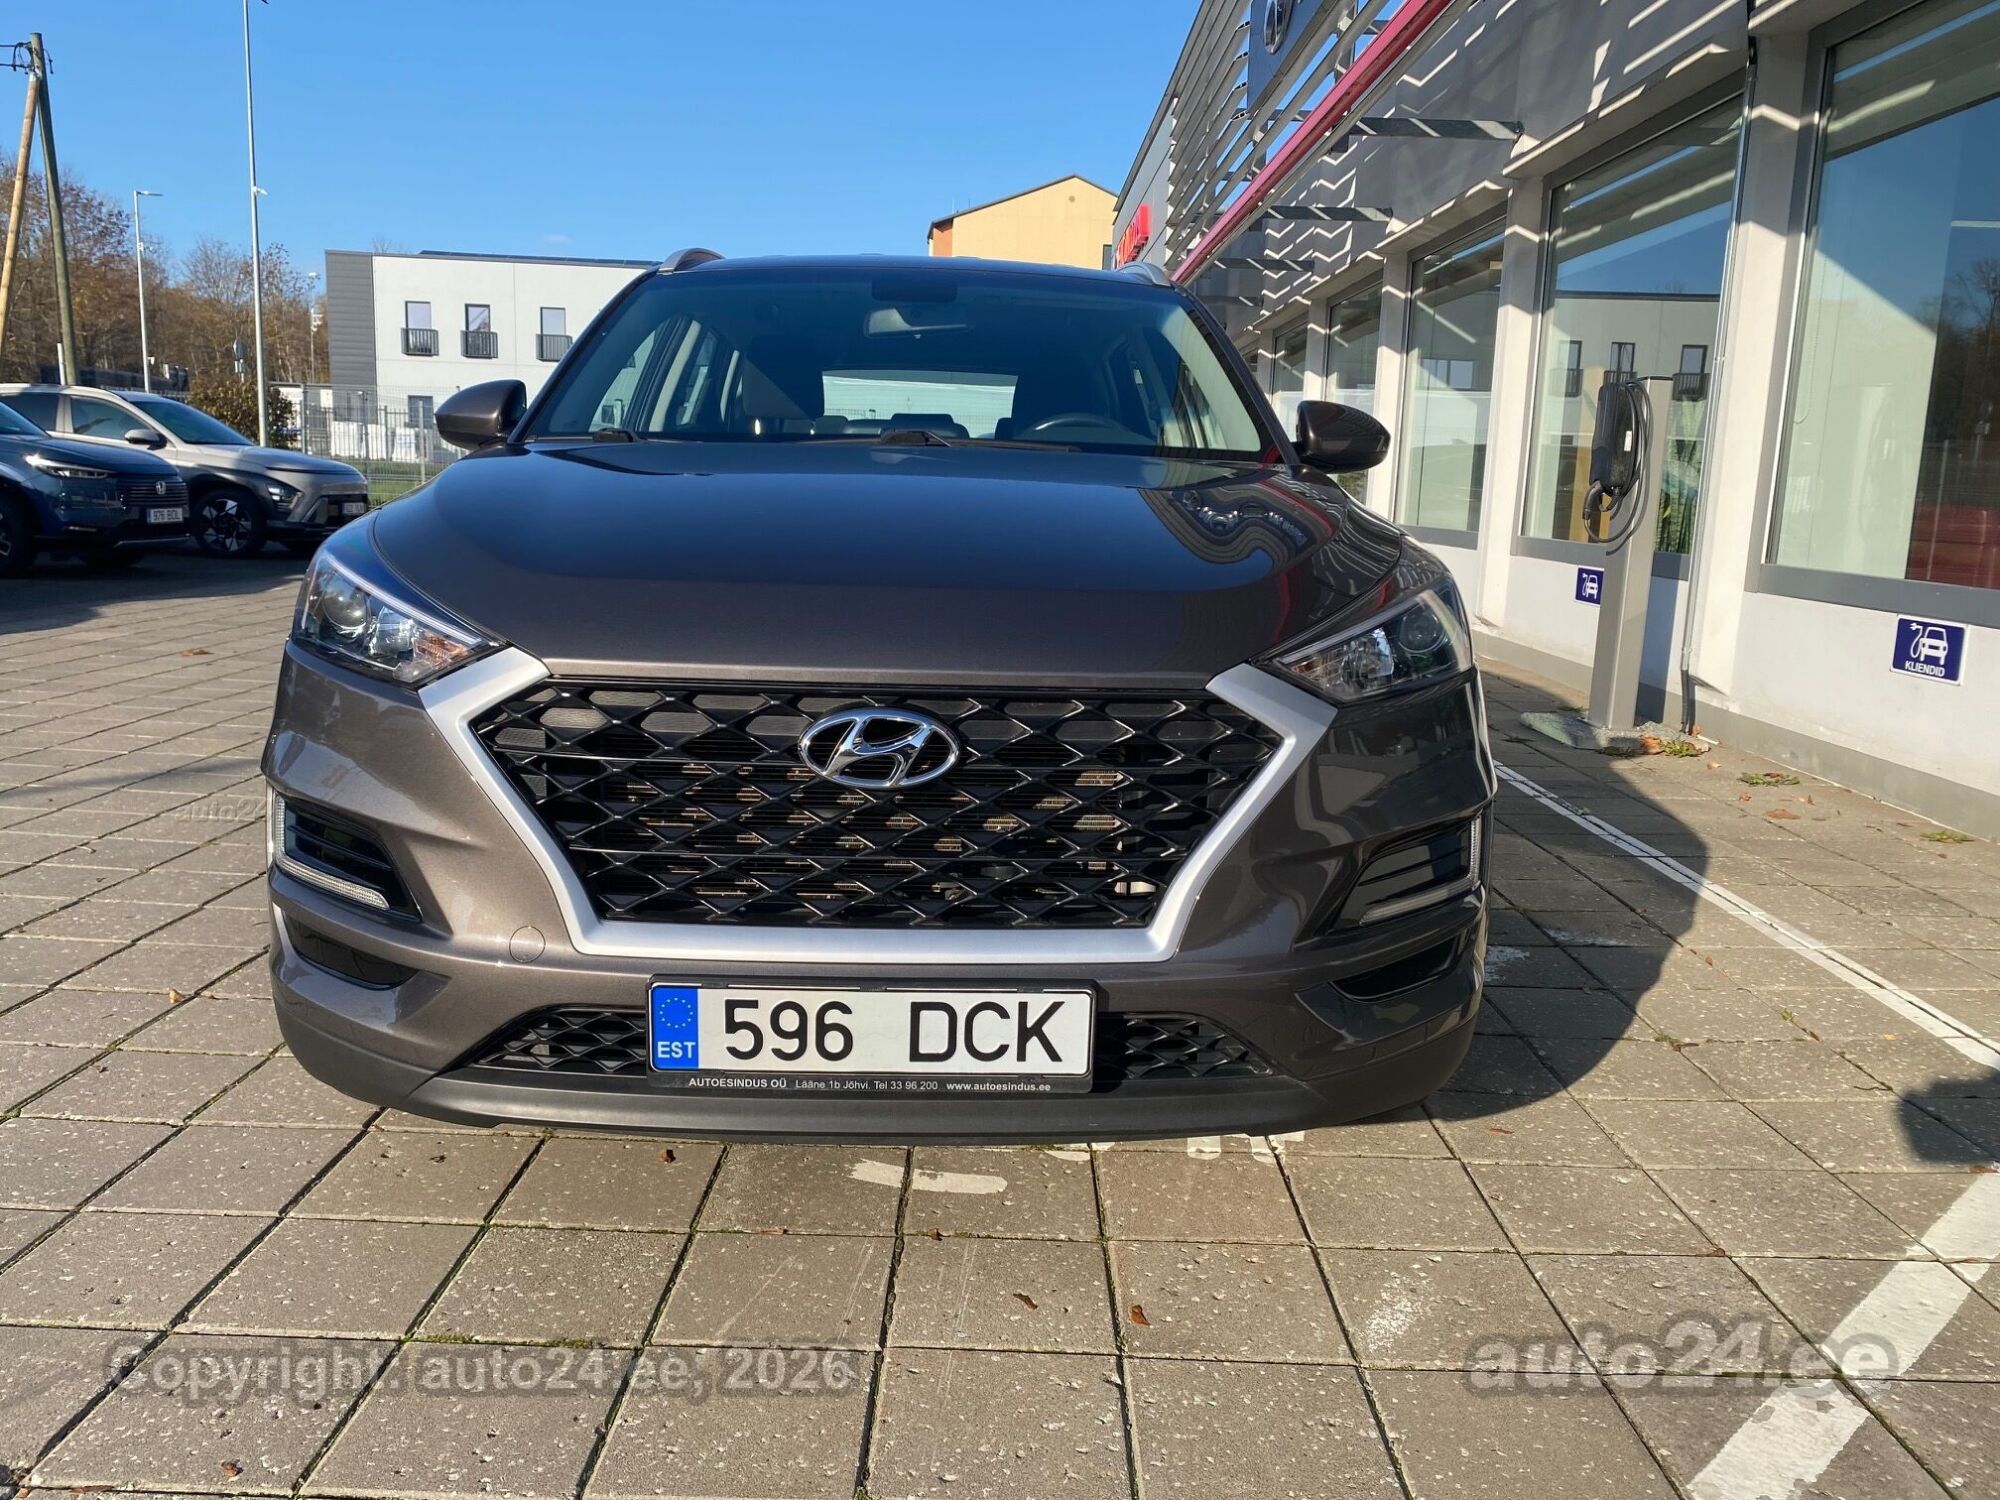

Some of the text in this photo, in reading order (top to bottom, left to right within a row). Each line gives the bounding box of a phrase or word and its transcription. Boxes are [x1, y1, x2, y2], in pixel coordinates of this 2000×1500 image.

[1904, 660, 1946, 677] KLIENDID
[725, 998, 1066, 1063] 596 DCK
[657, 1041, 695, 1058] EST
[688, 1077, 768, 1088] AUTOESINDUS
[770, 1077, 787, 1088] OÜ
[795, 1079, 826, 1089] Lääne
[829, 1079, 841, 1089] 1b
[874, 1080, 888, 1090] Tel
[890, 1081, 902, 1090] 33
[905, 1081, 917, 1090] 96
[920, 1081, 938, 1090] 200
[946, 1081, 1051, 1091] www.autoesindus.ee
